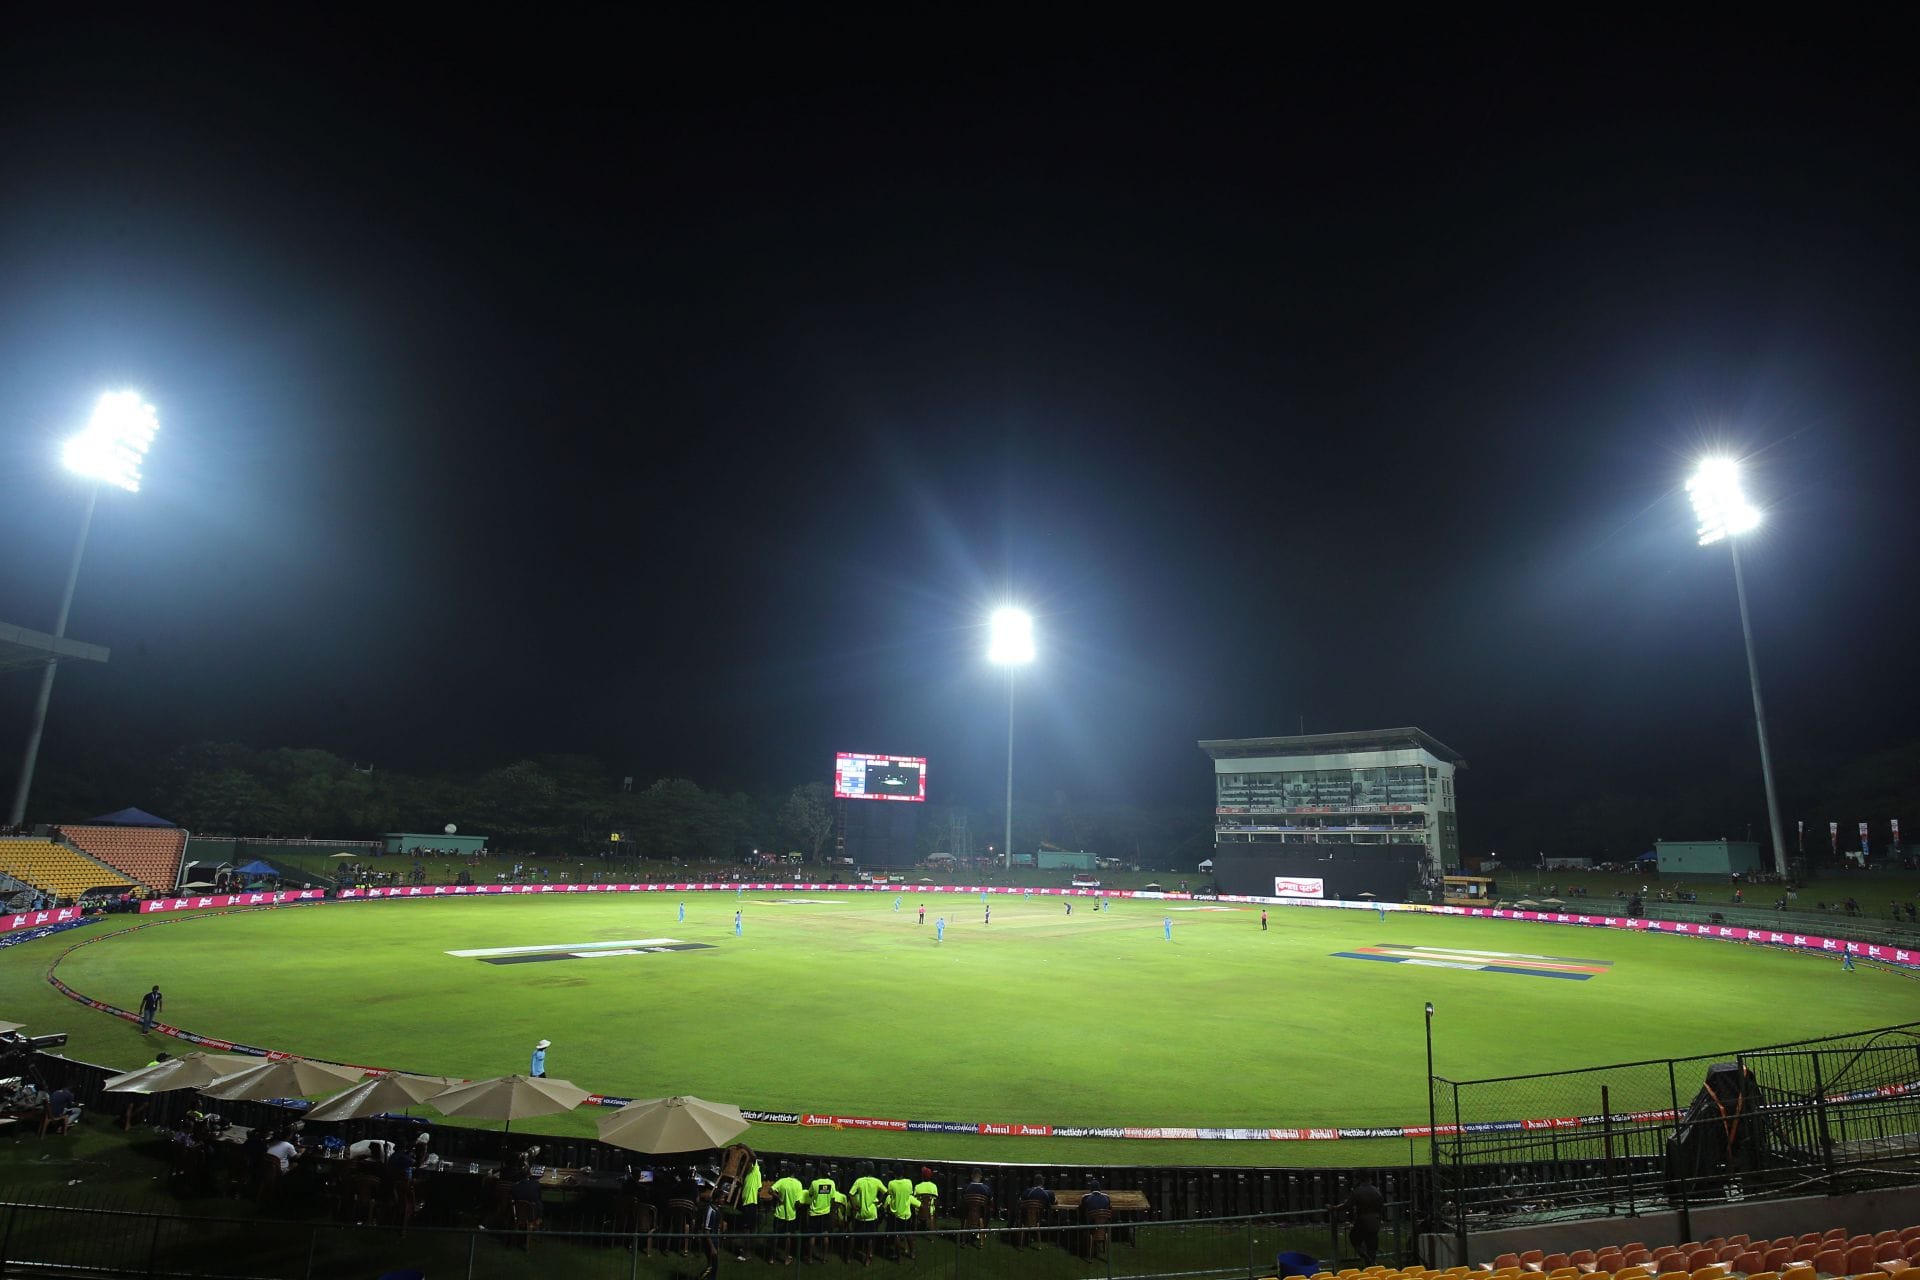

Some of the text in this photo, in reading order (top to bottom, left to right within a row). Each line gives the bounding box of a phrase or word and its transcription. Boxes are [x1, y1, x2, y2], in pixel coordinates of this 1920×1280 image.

[769, 1114, 792, 1122] Hettich
[806, 1114, 832, 1124] Amul
[984, 1124, 1010, 1134] Amul
[1021, 1125, 1047, 1135] Amul
